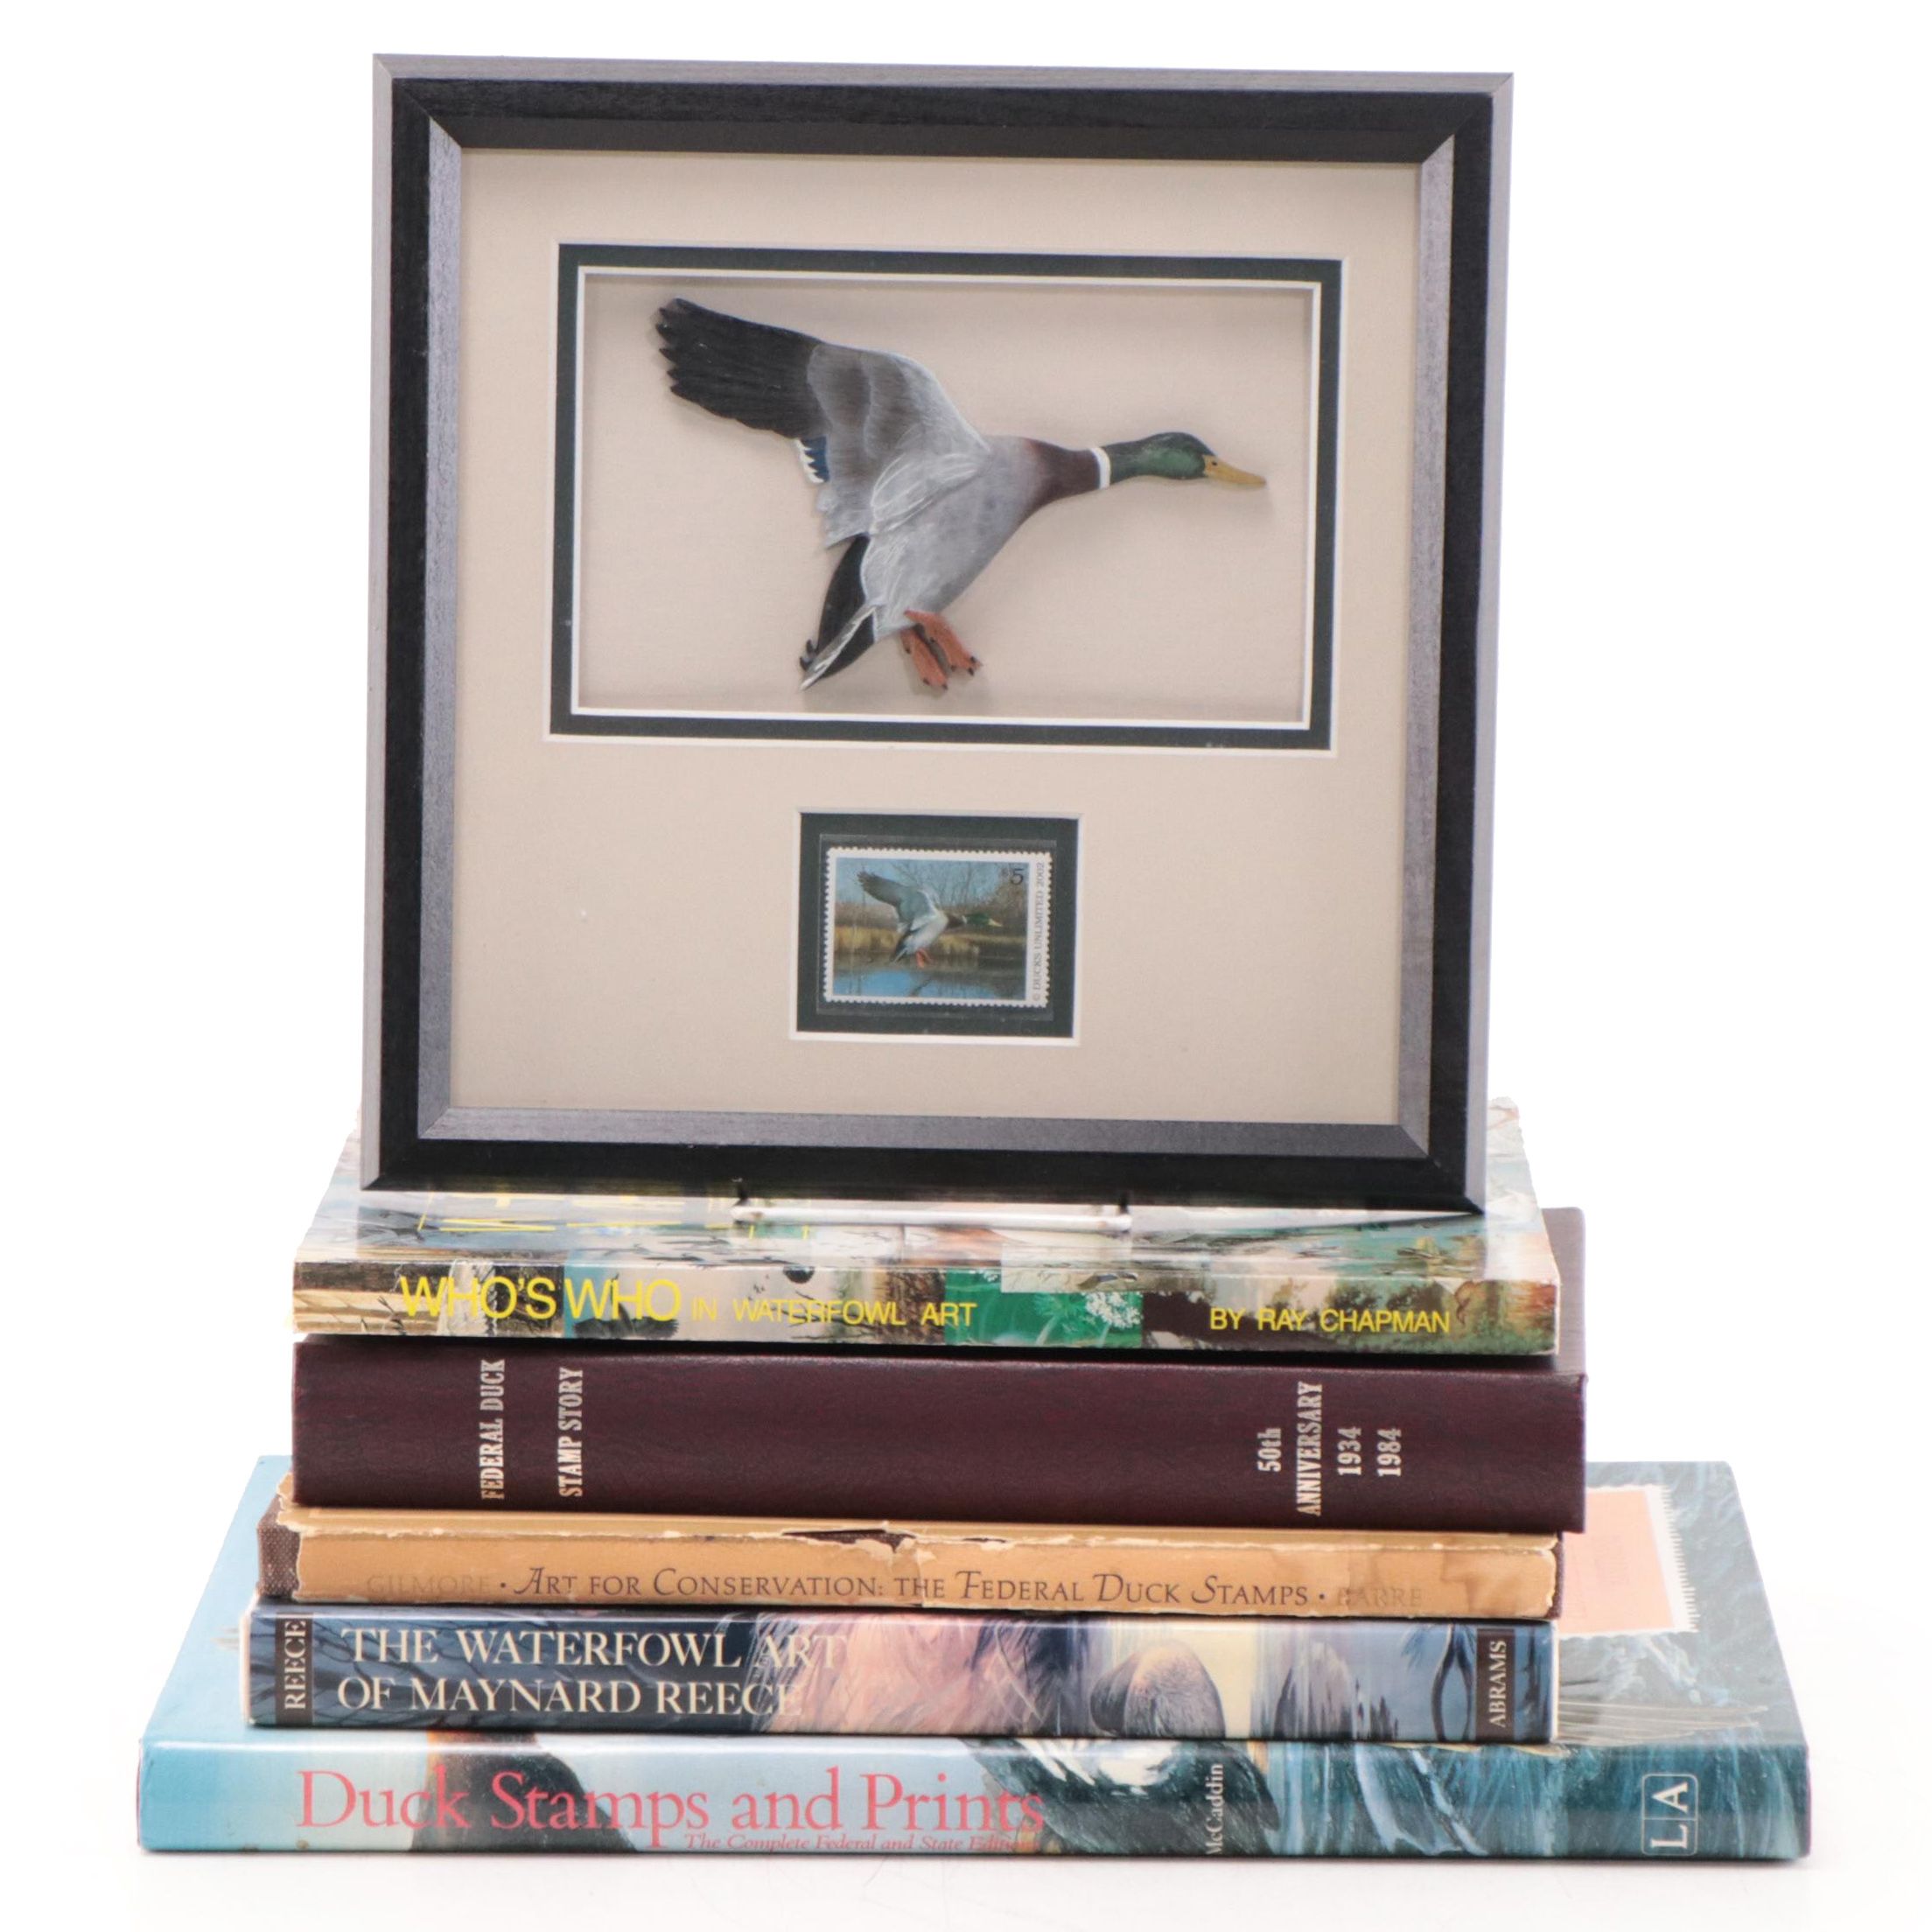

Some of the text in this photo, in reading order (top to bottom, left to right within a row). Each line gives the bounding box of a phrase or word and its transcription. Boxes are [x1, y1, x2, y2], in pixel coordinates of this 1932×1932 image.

[1034, 892, 1045, 950] UNLIMITED
[1033, 955, 1042, 990] DUCKS
[400, 1276, 977, 1326] WHO'S WHO IN WATERFOWL ART
[1209, 1307, 1451, 1334] BY RAY CHAPMAN
[480, 1359, 506, 1500] FEDERAL DUCK
[557, 1367, 584, 1498] STAMP STORY
[1256, 1427, 1282, 1473] 50th
[1296, 1381, 1323, 1517] ANNIVERSARY
[1337, 1425, 1362, 1476] 1934
[1376, 1426, 1403, 1477] 1984
[366, 1574, 491, 1596] GILMORE
[514, 1566, 578, 1595] ART
[590, 1575, 641, 1596] FOR
[653, 1567, 884, 1598] CONSERVATION:
[894, 1577, 945, 1599] THE
[955, 1570, 1084, 1602] FEDERAL
[1092, 1572, 1180, 1605] DUCK
[1191, 1575, 1309, 1606] STAMPS
[284, 1620, 306, 1711] REECE
[341, 1627, 849, 1669] THE WATERFOWL ART
[338, 1676, 805, 1716] OF MAYNARD REECE
[1488, 1640, 1508, 1728] ABRAMS
[295, 1764, 1046, 1850] Duck Stamps and Prints
[686, 1832, 721, 1851] The
[727, 1833, 809, 1854] Complete
[816, 1834, 876, 1851] Federal
[881, 1835, 914, 1851] and
[921, 1836, 962, 1852] State
